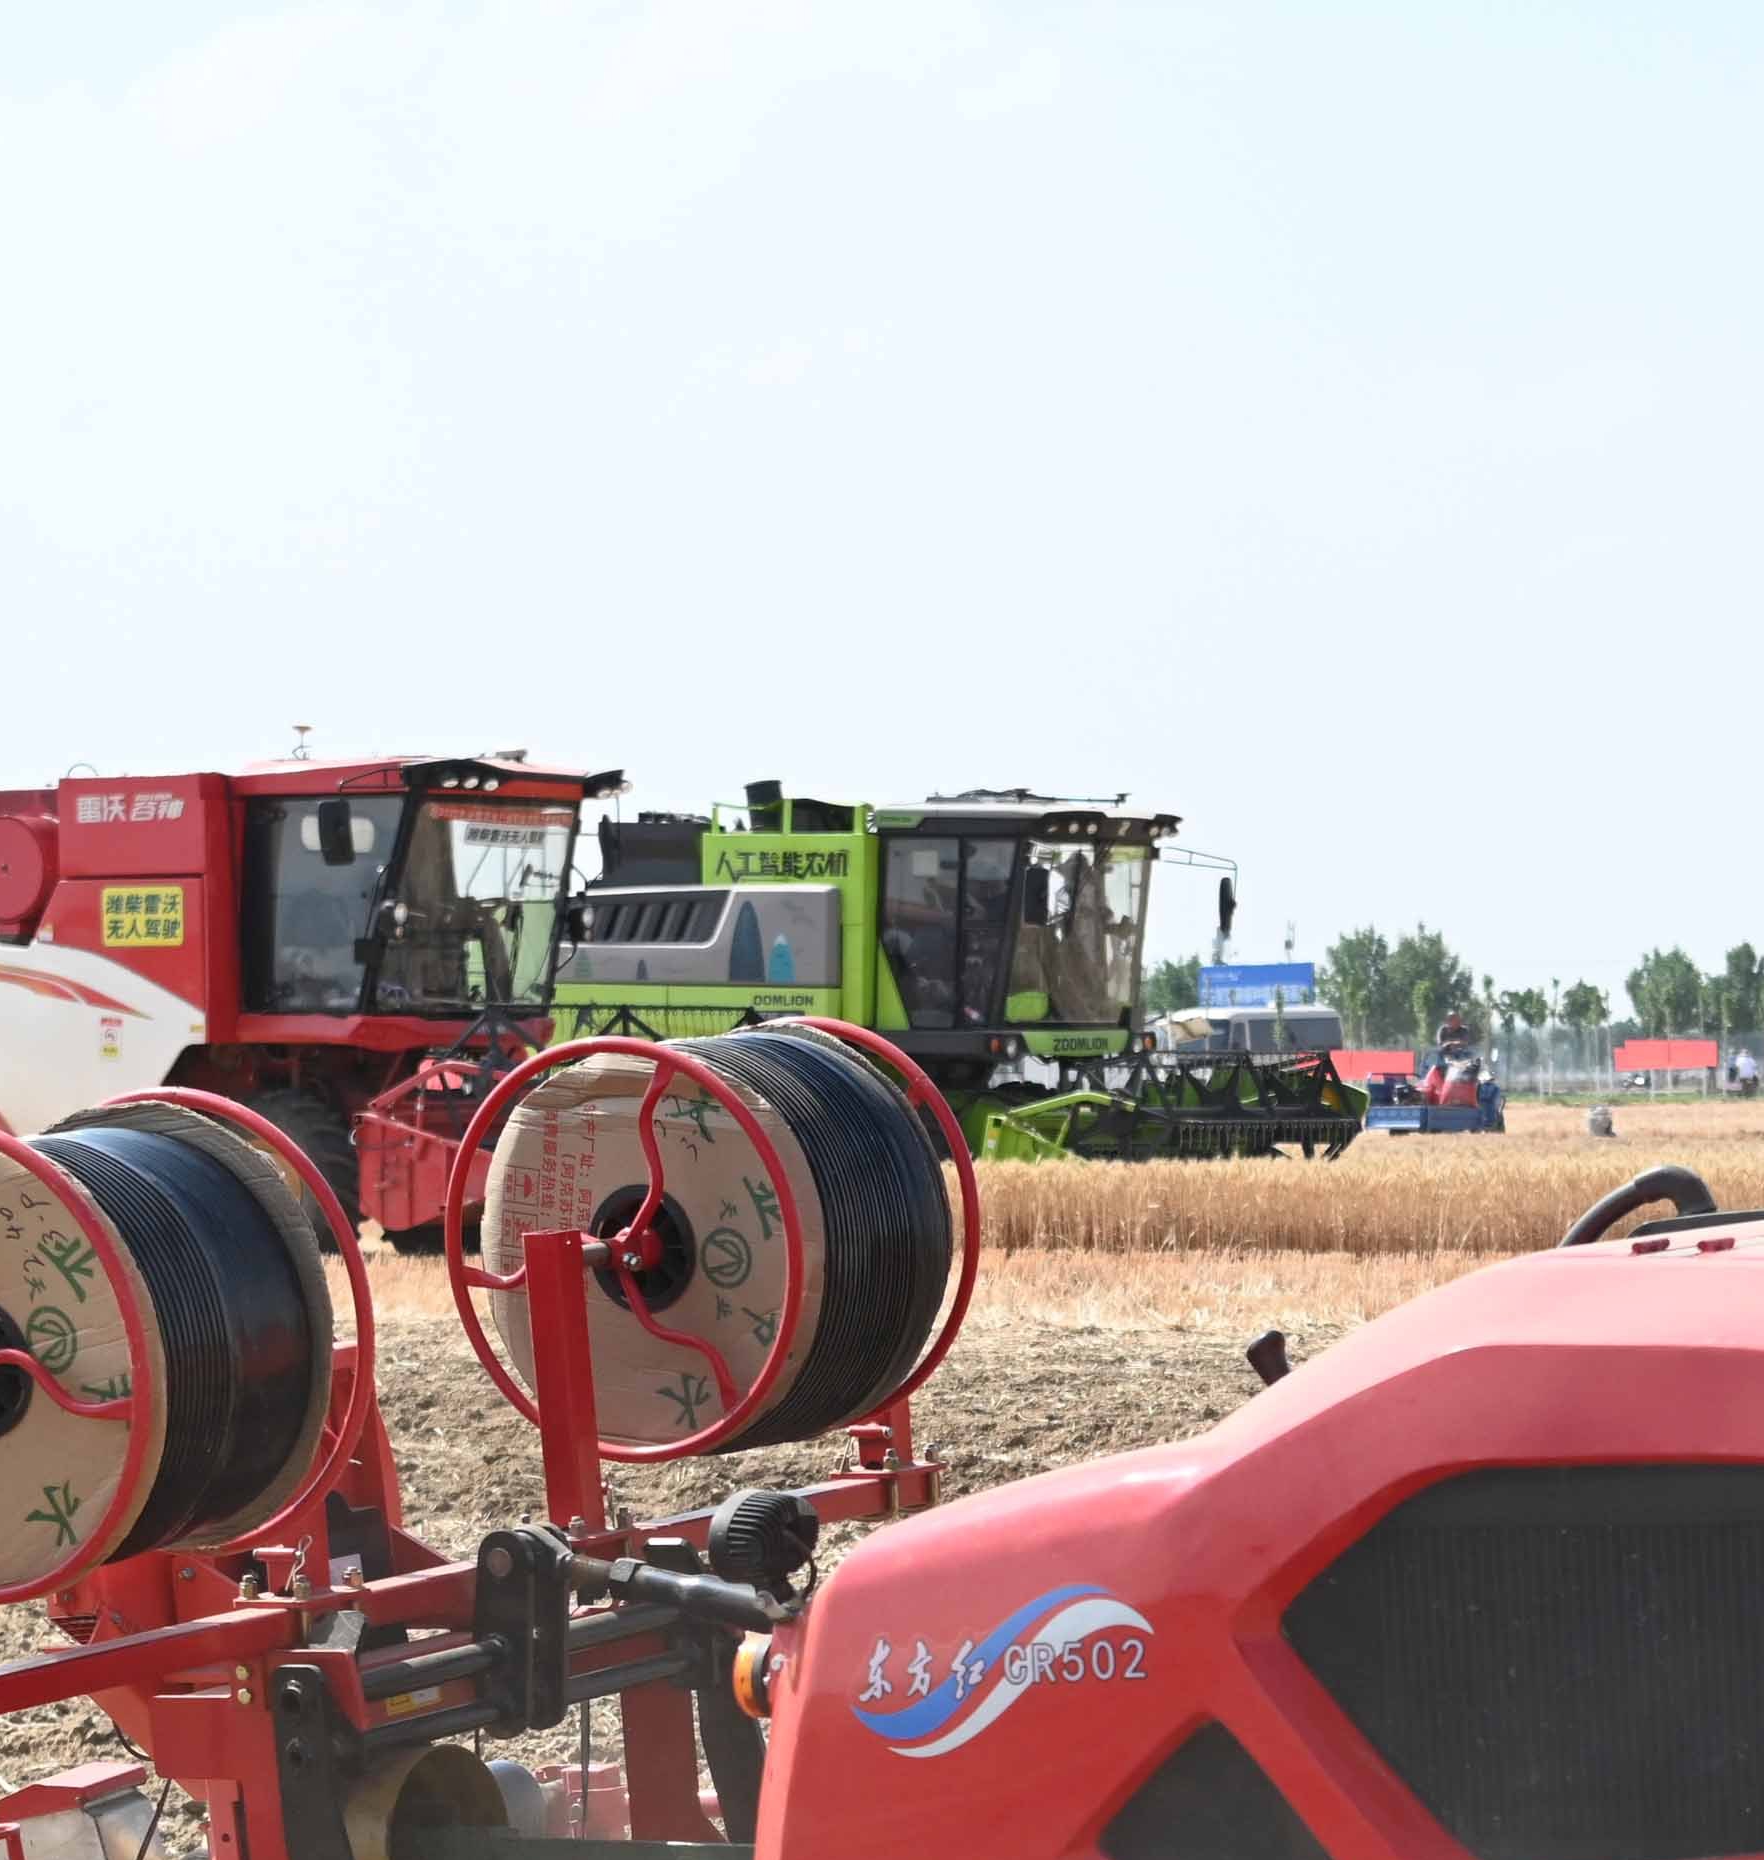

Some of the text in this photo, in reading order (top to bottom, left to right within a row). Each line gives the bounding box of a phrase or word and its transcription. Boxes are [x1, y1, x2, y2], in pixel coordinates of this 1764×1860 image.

[716, 849, 849, 882] 人工智能农机
[106, 894, 181, 914] 潍柴雷沃
[107, 919, 181, 938] 无人驾驶
[859, 1639, 986, 1702] 东方红
